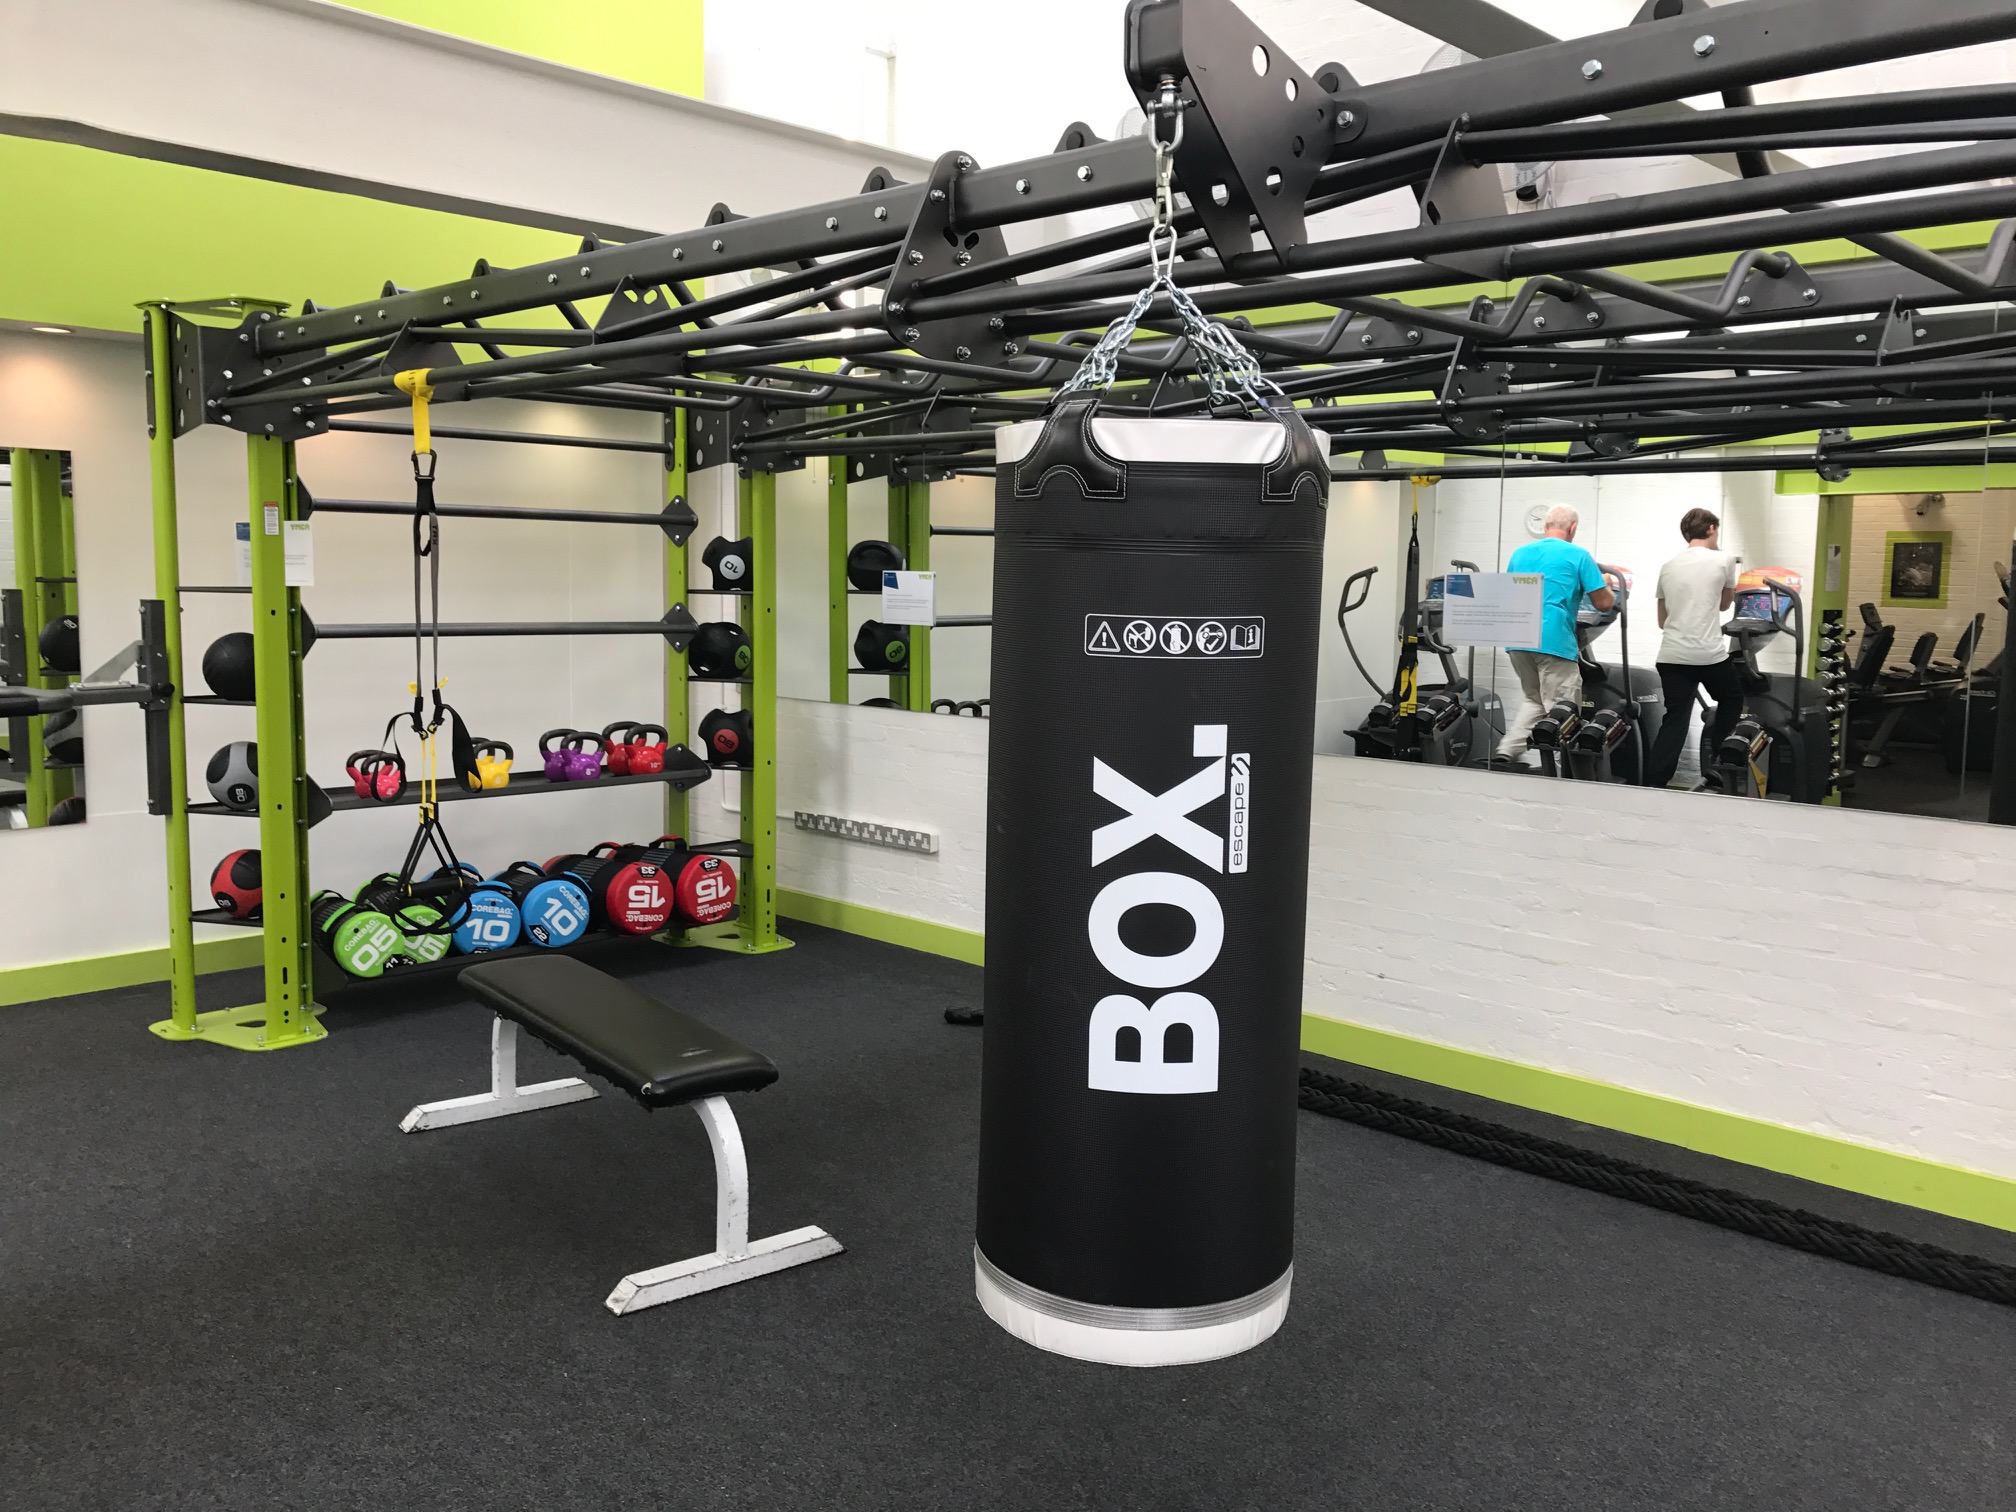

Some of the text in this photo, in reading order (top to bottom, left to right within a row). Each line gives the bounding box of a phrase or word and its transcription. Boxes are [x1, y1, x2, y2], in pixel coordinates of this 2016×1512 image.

[1513, 577, 1538, 585] YMCA
[1233, 782, 1247, 866] escape
[641, 866, 656, 875] 33
[704, 859, 718, 869] 33
[628, 885, 666, 908] 15
[695, 876, 731, 904] 15
[543, 897, 578, 937] 10
[1088, 724, 1227, 1094] BOX.
[465, 918, 510, 942] 10
[532, 927, 548, 942] 22
[351, 924, 398, 972] 05
